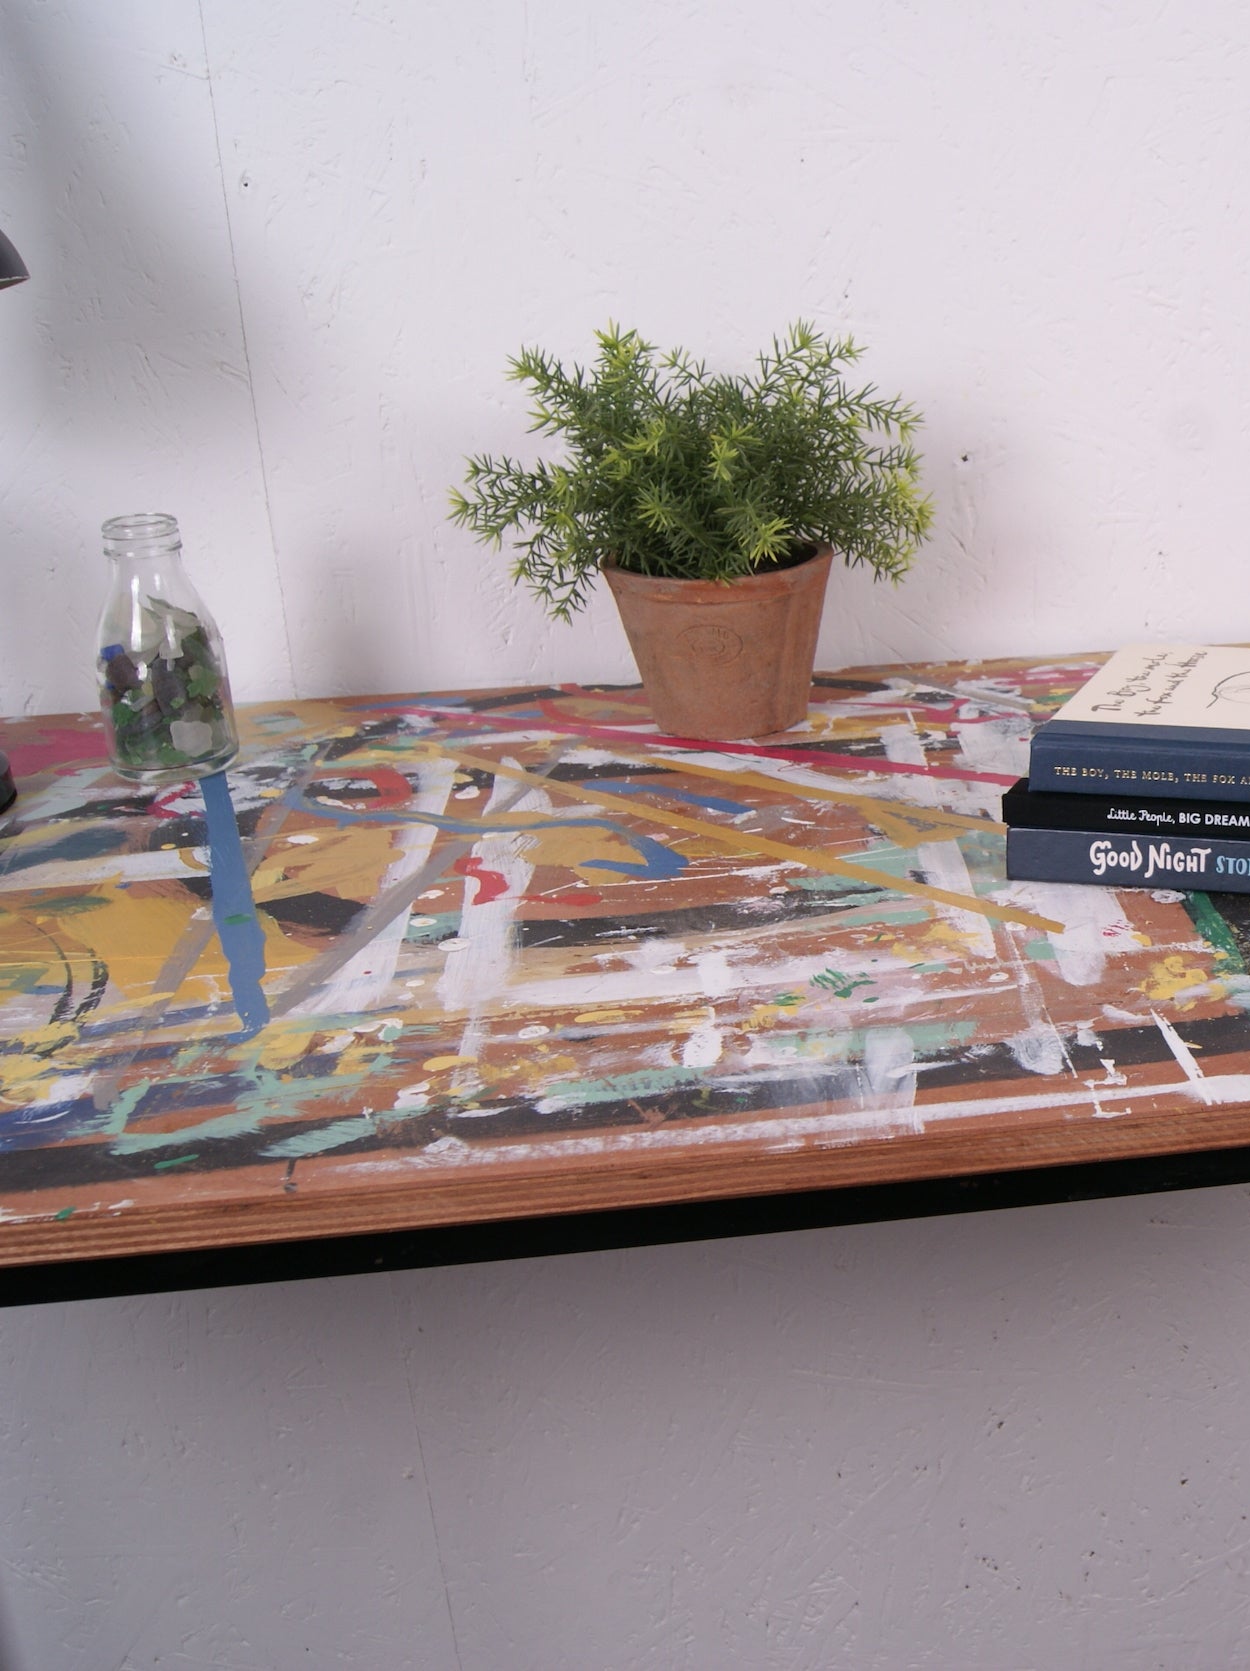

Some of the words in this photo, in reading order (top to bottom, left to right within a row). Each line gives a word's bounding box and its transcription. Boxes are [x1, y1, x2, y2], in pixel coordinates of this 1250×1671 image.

[1091, 699, 1125, 712] The
[1054, 766, 1077, 776] THE
[1081, 768, 1109, 780] BOY,
[1114, 769, 1137, 779] THE
[1142, 771, 1179, 783] MOLE,
[1184, 773, 1208, 783] THE
[1212, 774, 1236, 785] FOX
[1107, 807, 1137, 821] Little
[1138, 809, 1175, 826] People,
[1179, 812, 1201, 824] BIG
